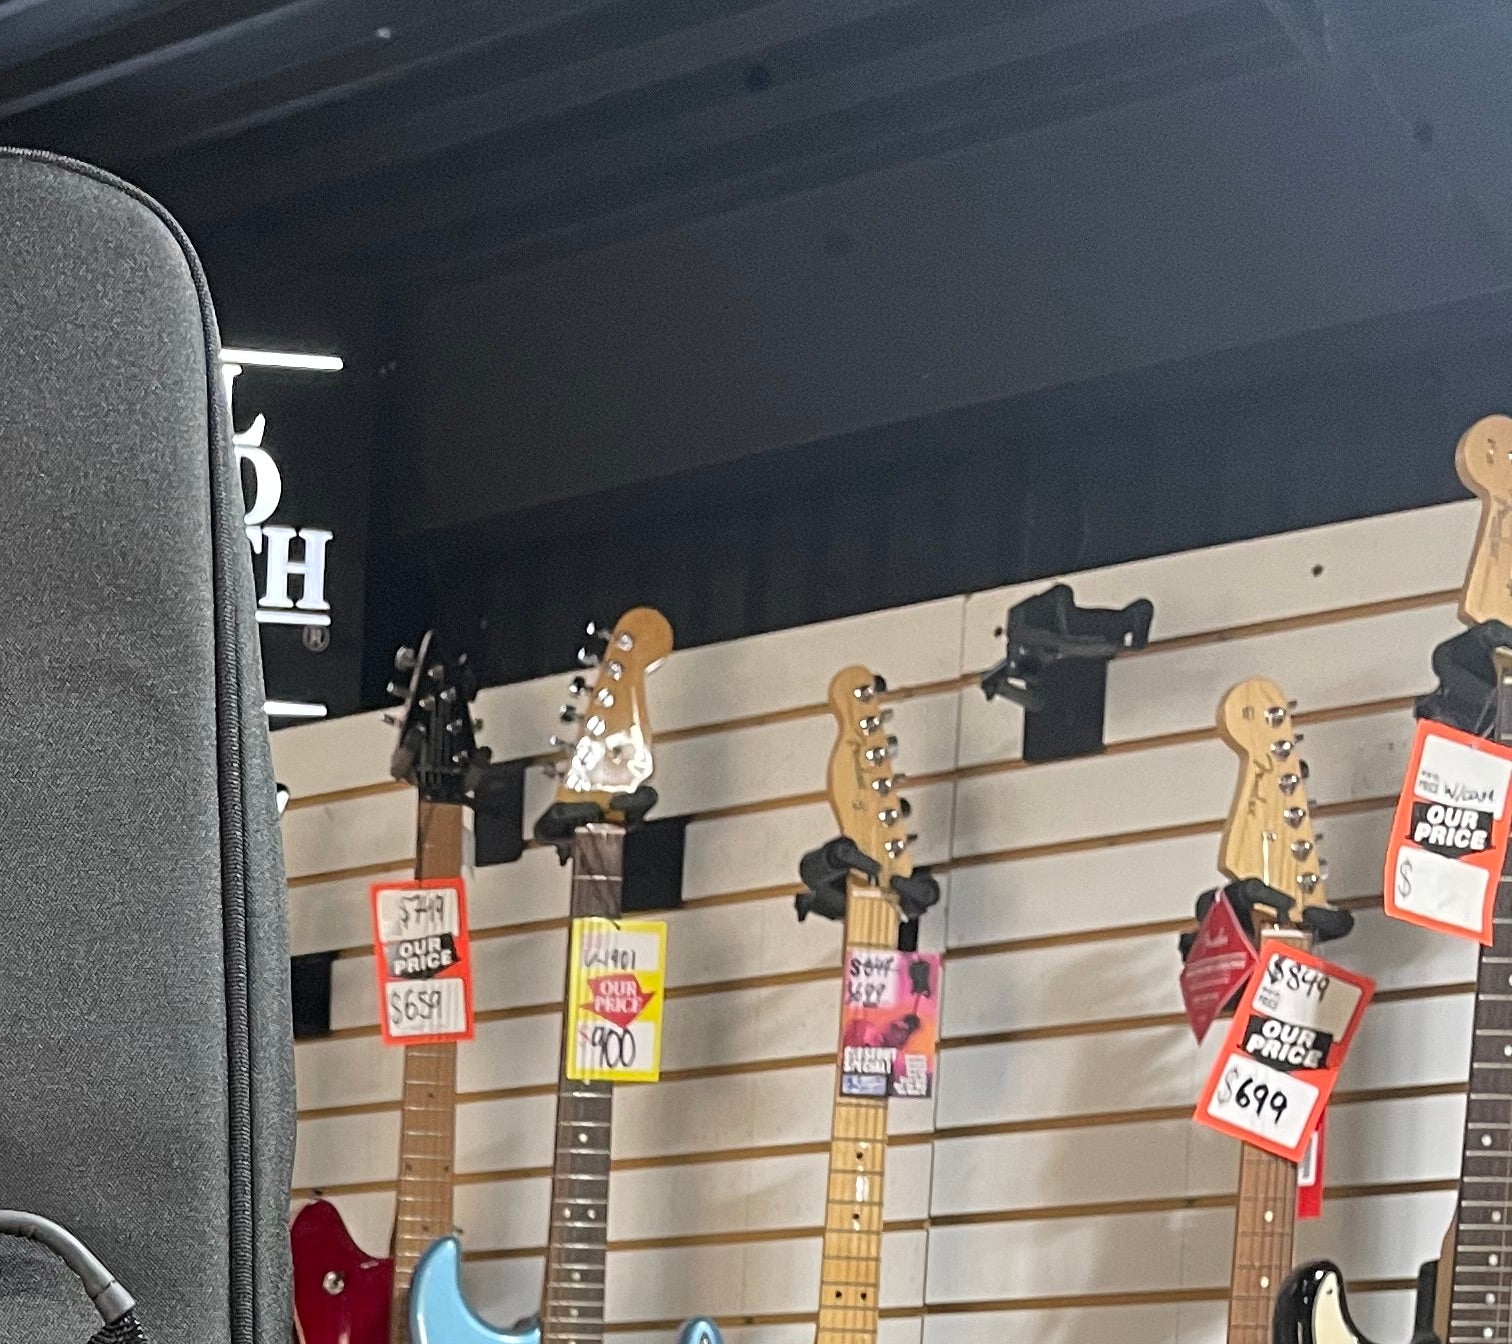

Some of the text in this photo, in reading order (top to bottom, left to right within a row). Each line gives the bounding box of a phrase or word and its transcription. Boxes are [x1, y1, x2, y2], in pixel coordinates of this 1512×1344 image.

[1425, 804, 1480, 829] OUR
[1413, 823, 1488, 851] PRICE
[398, 936, 443, 960] OUR
[392, 948, 454, 976] PRICE
[598, 980, 638, 997] OUR
[593, 996, 644, 1014] PRICE
[1261, 1018, 1317, 1048] OUR
[1245, 1036, 1324, 1069] PRICE
